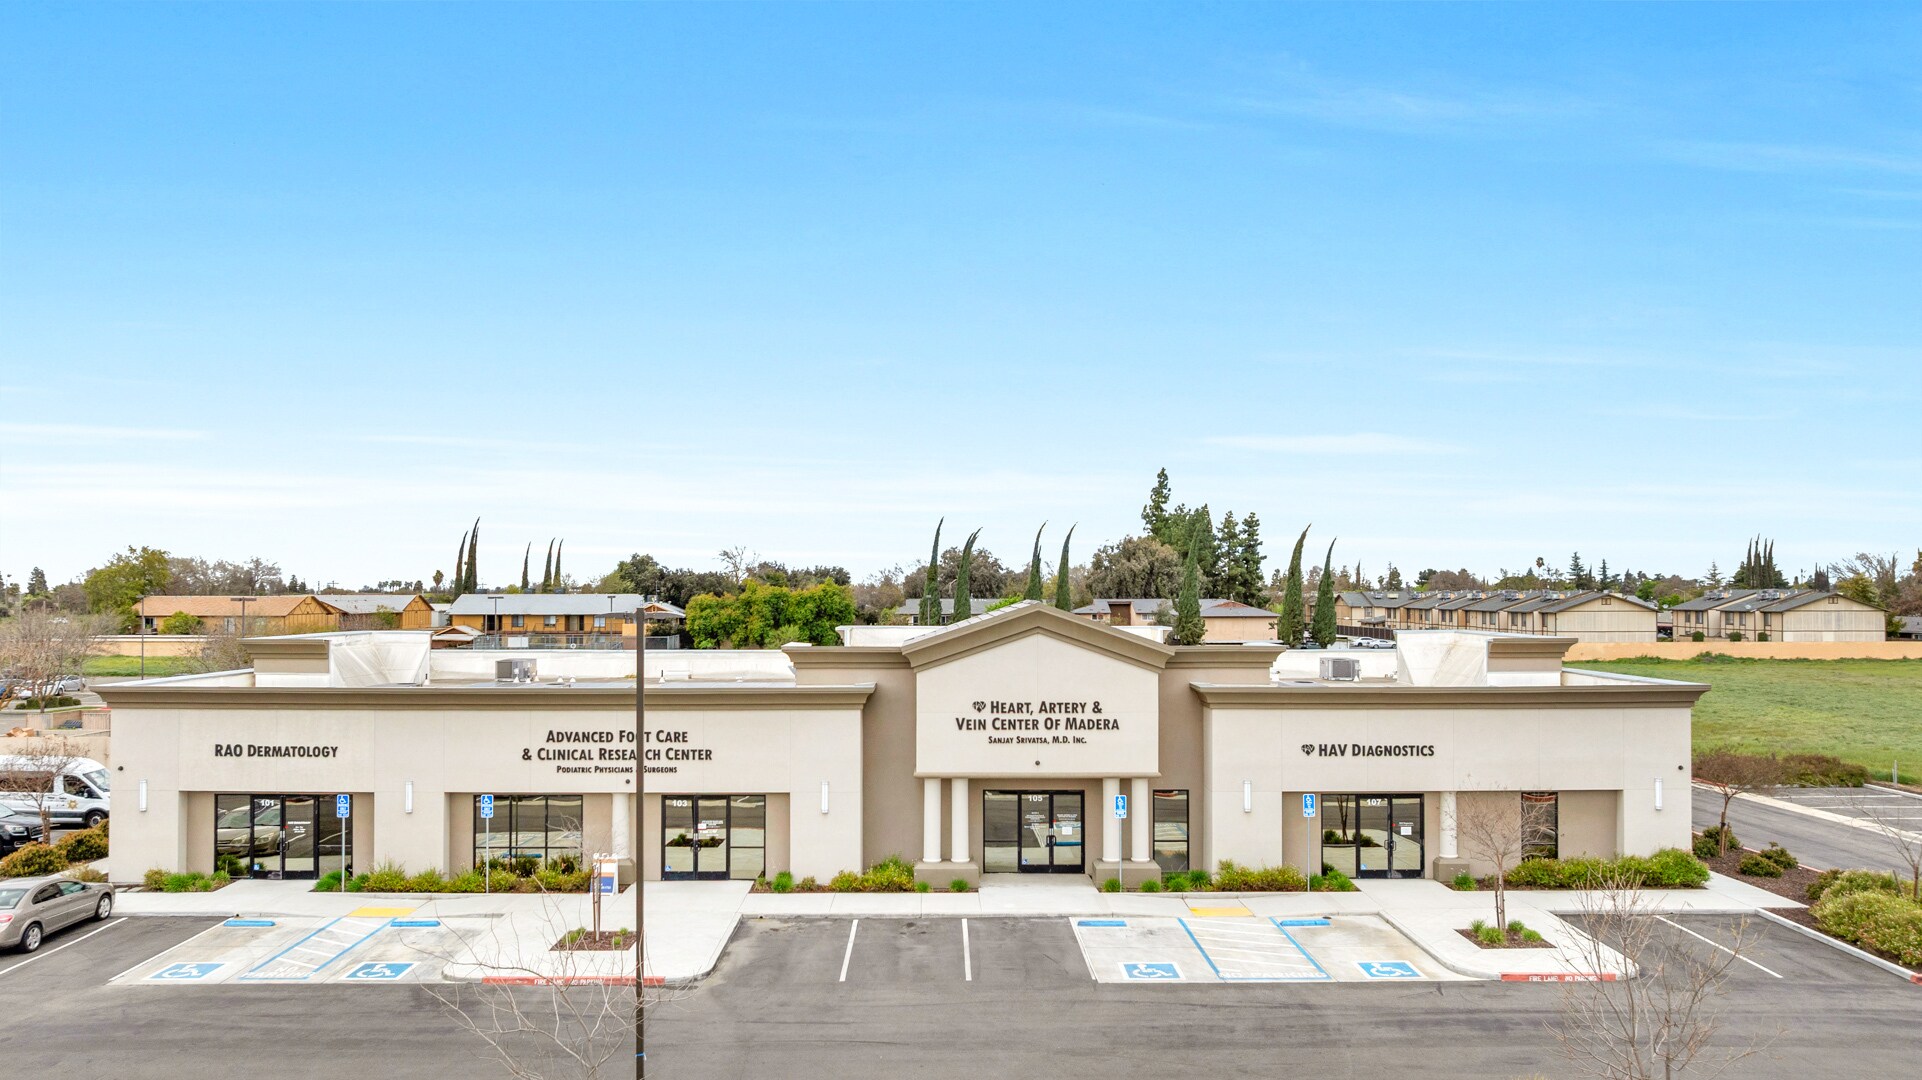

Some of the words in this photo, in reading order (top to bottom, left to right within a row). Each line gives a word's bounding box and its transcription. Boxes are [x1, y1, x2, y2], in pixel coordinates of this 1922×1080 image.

[990, 701, 1034, 715] HEART,
[1038, 701, 1087, 714] ARTERY
[1092, 701, 1102, 714] &
[956, 717, 987, 730] VEIN
[992, 717, 1039, 730] CENTER
[1044, 717, 1061, 730] OF
[1065, 717, 1120, 730] MADERA
[546, 730, 614, 743] ADVANCED
[619, 730, 651, 743] FOT
[656, 730, 688, 743] CARE
[988, 736, 1013, 744] SANJAY
[1016, 736, 1050, 745] SRIVATSA,
[1052, 736, 1070, 744] M.D.
[1073, 736, 1087, 744] INC.
[215, 744, 243, 757] RAO
[247, 744, 338, 757] DERMATOLOGY
[522, 748, 532, 761] &
[537, 747, 594, 760] CLINICAL
[599, 747, 661, 760] RESEACH
[666, 747, 712, 760] CENTER
[1319, 744, 1348, 756] HAV
[1352, 744, 1435, 757] DIAGNOSTICS
[643, 765, 677, 773] SURGEONS
